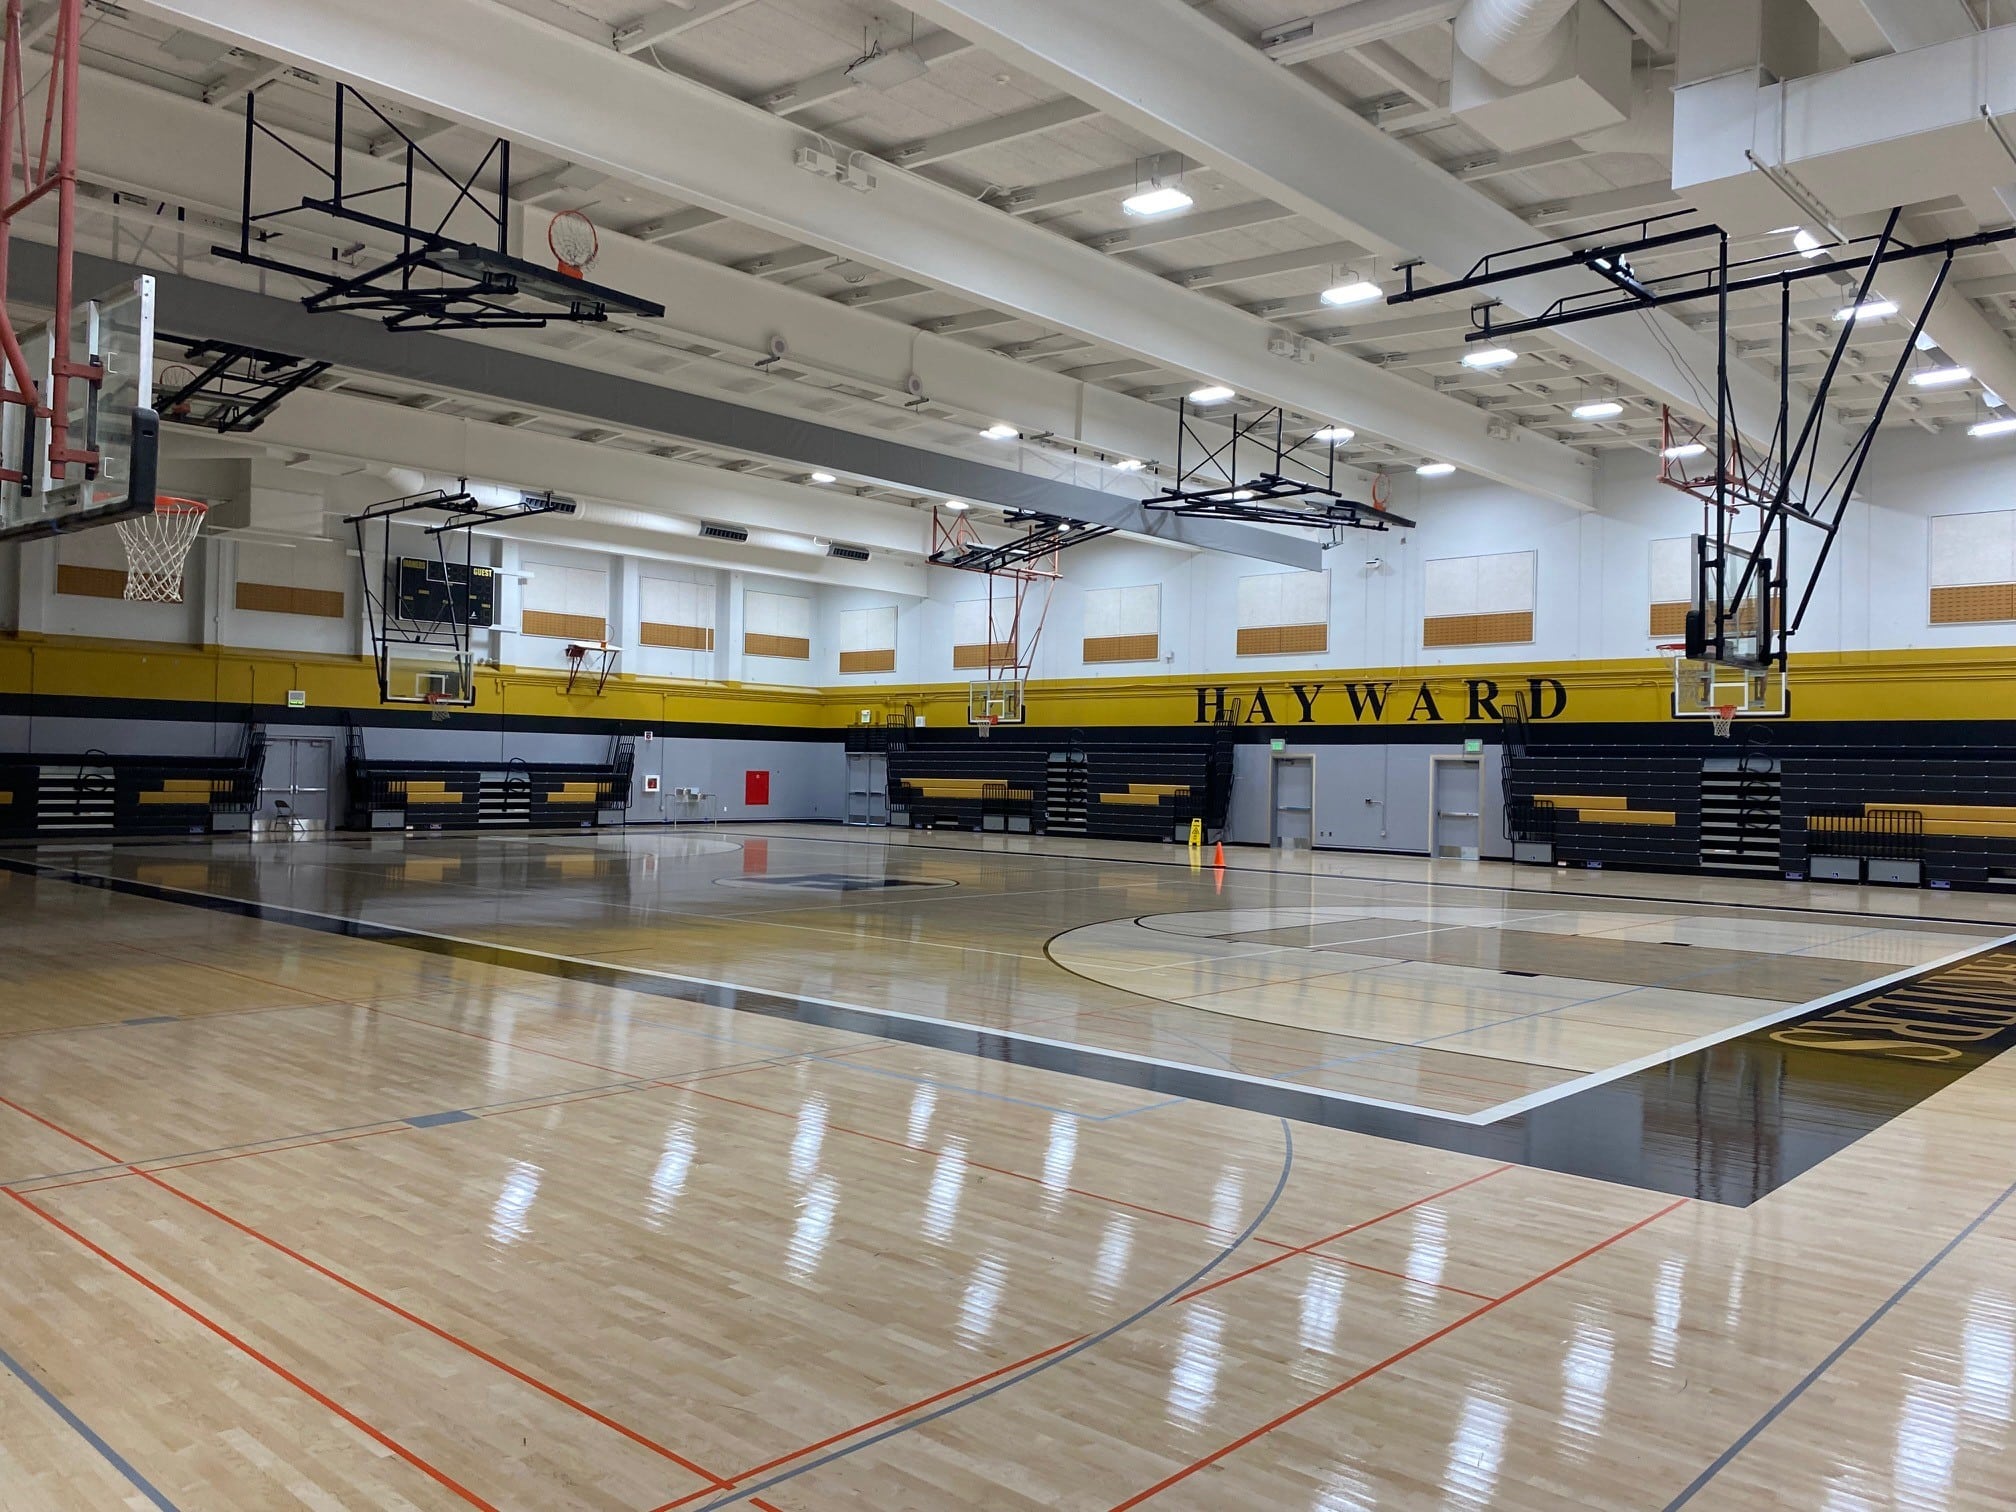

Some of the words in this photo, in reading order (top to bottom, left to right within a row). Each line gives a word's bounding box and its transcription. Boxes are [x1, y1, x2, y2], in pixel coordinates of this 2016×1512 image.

[473, 568, 492, 578] GUEST
[1193, 678, 1567, 724] HAYWARD
[1769, 953, 2016, 1062] RMERS
